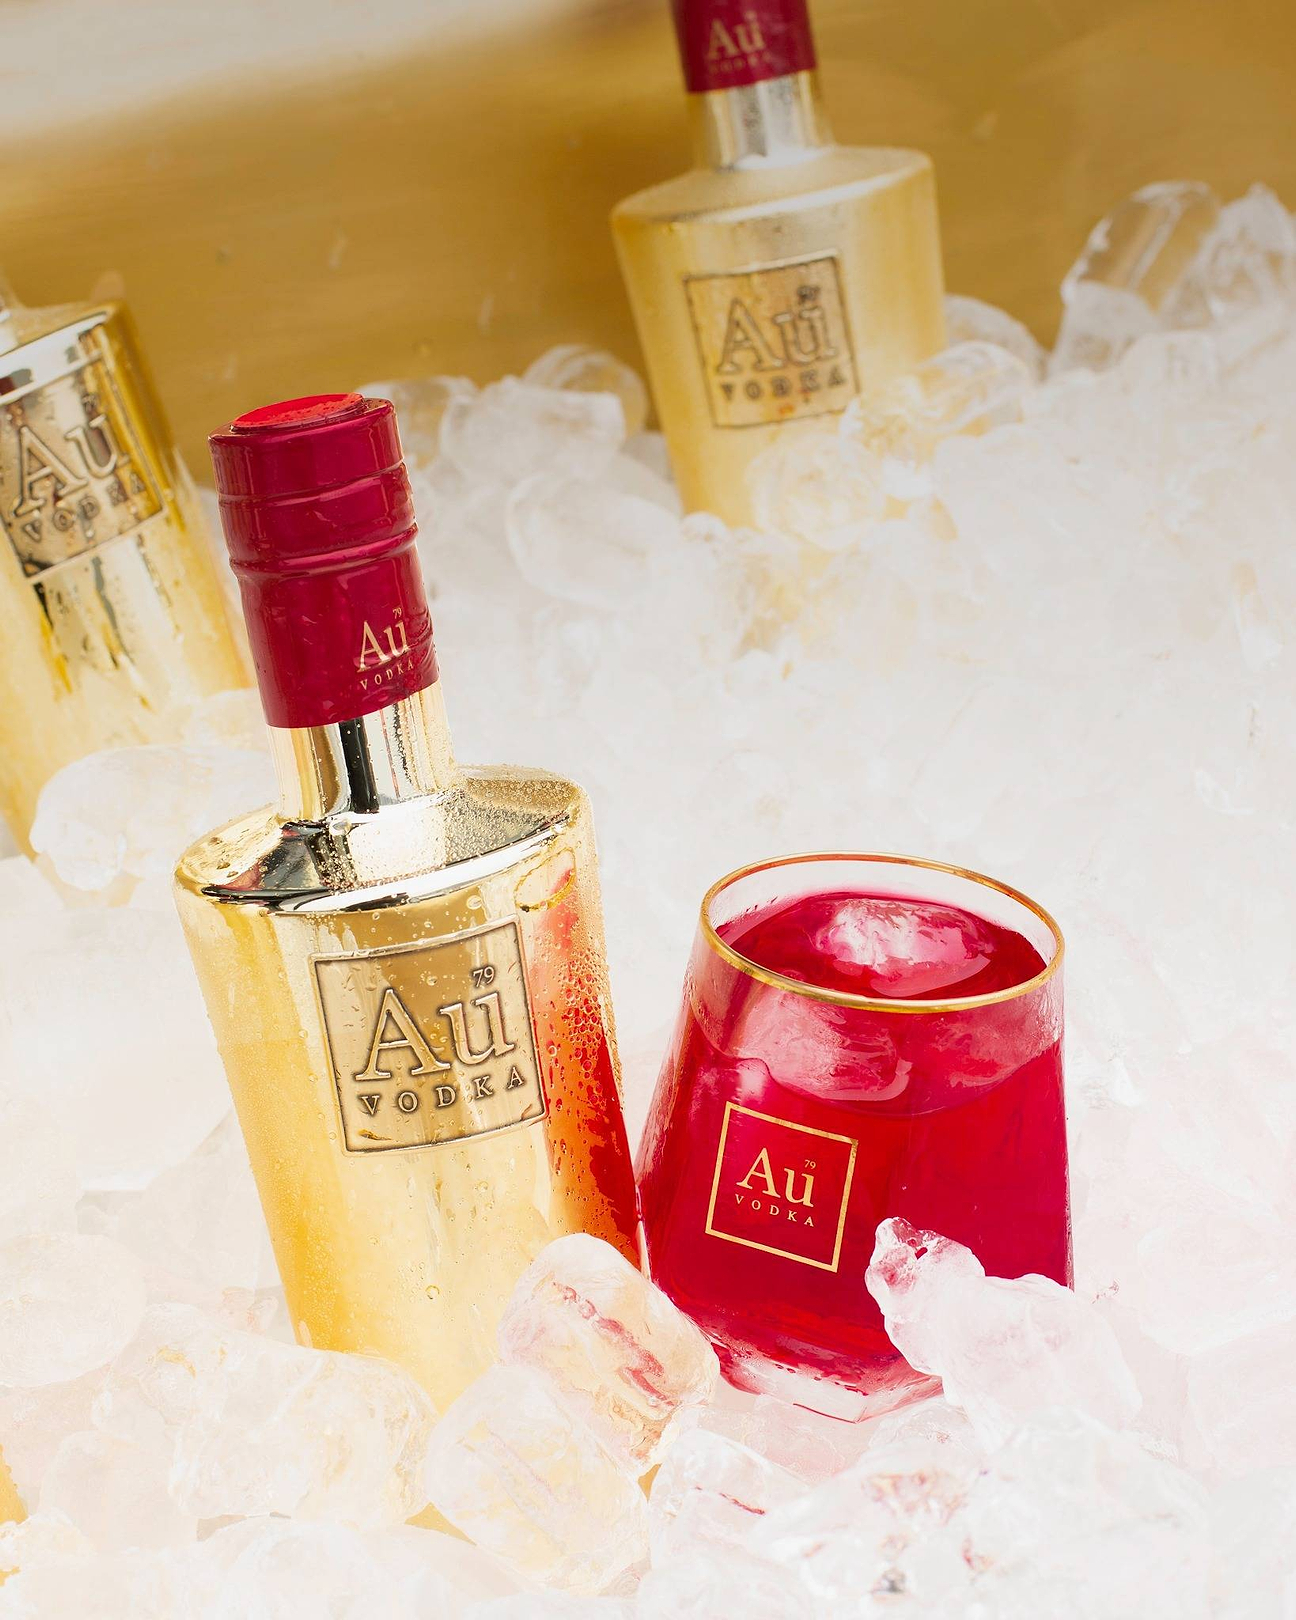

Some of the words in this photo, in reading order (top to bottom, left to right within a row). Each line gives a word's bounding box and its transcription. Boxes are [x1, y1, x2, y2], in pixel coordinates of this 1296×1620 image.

[707, 18, 765, 60] Au
[716, 297, 838, 375] Au
[13, 413, 130, 518] Au
[393, 607, 402, 619] 79
[357, 620, 410, 673] Au
[360, 659, 414, 690] VODKA
[472, 966, 495, 988] 79
[355, 988, 515, 1081] Au
[361, 1066, 525, 1116] VODKA
[736, 1147, 815, 1208] Au
[804, 1159, 817, 1170] 79
[734, 1193, 815, 1227] VODKA
